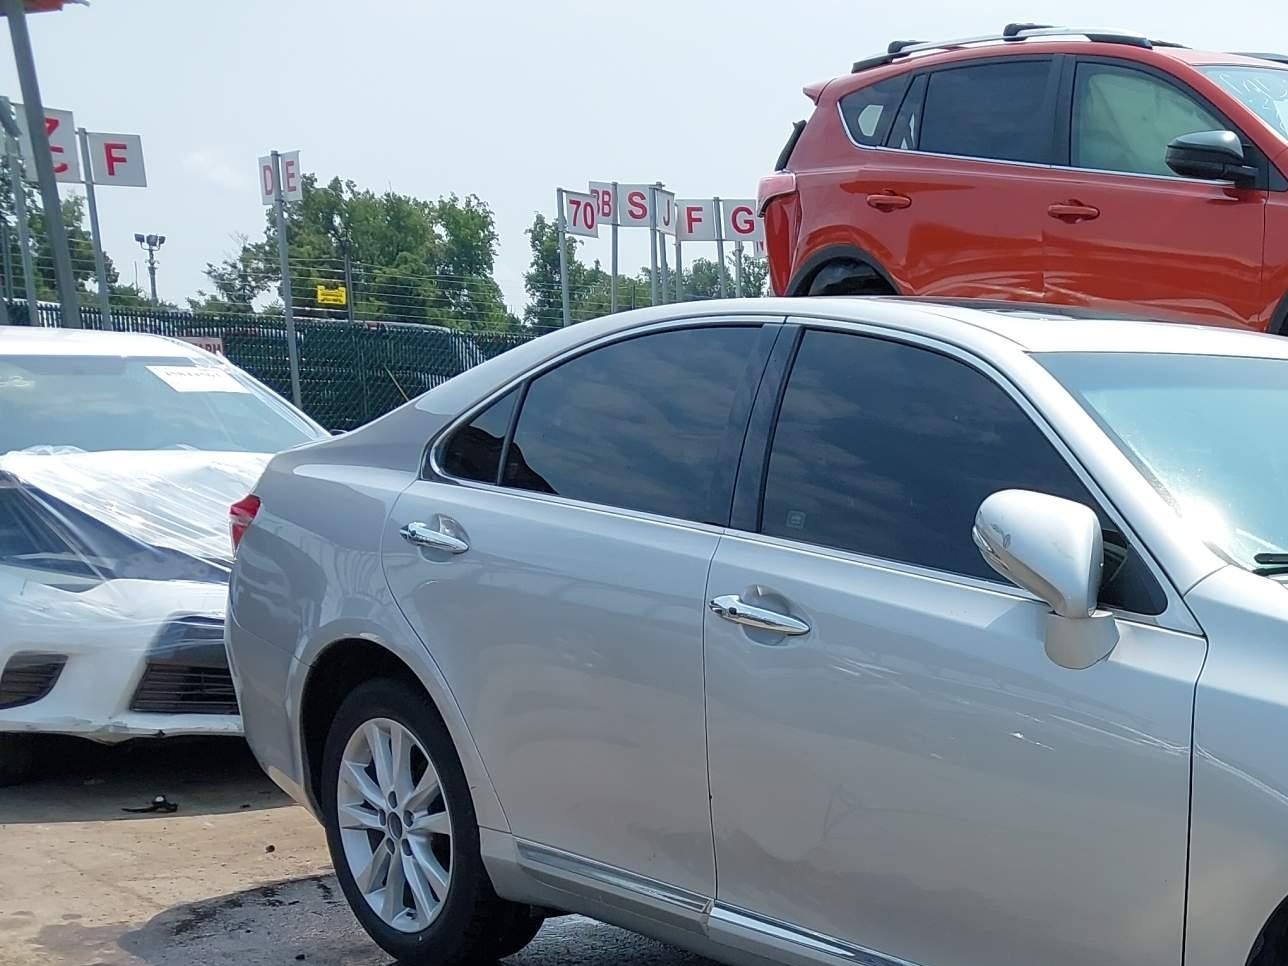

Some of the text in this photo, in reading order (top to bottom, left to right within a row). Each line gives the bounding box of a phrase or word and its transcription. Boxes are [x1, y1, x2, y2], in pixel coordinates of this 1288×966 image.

[104, 143, 128, 176] F
[286, 160, 297, 192] E
[569, 198, 595, 230] 70
[627, 191, 648, 220] S
[662, 199, 671, 227] J
[686, 206, 703, 234] F
[731, 206, 756, 235] G
